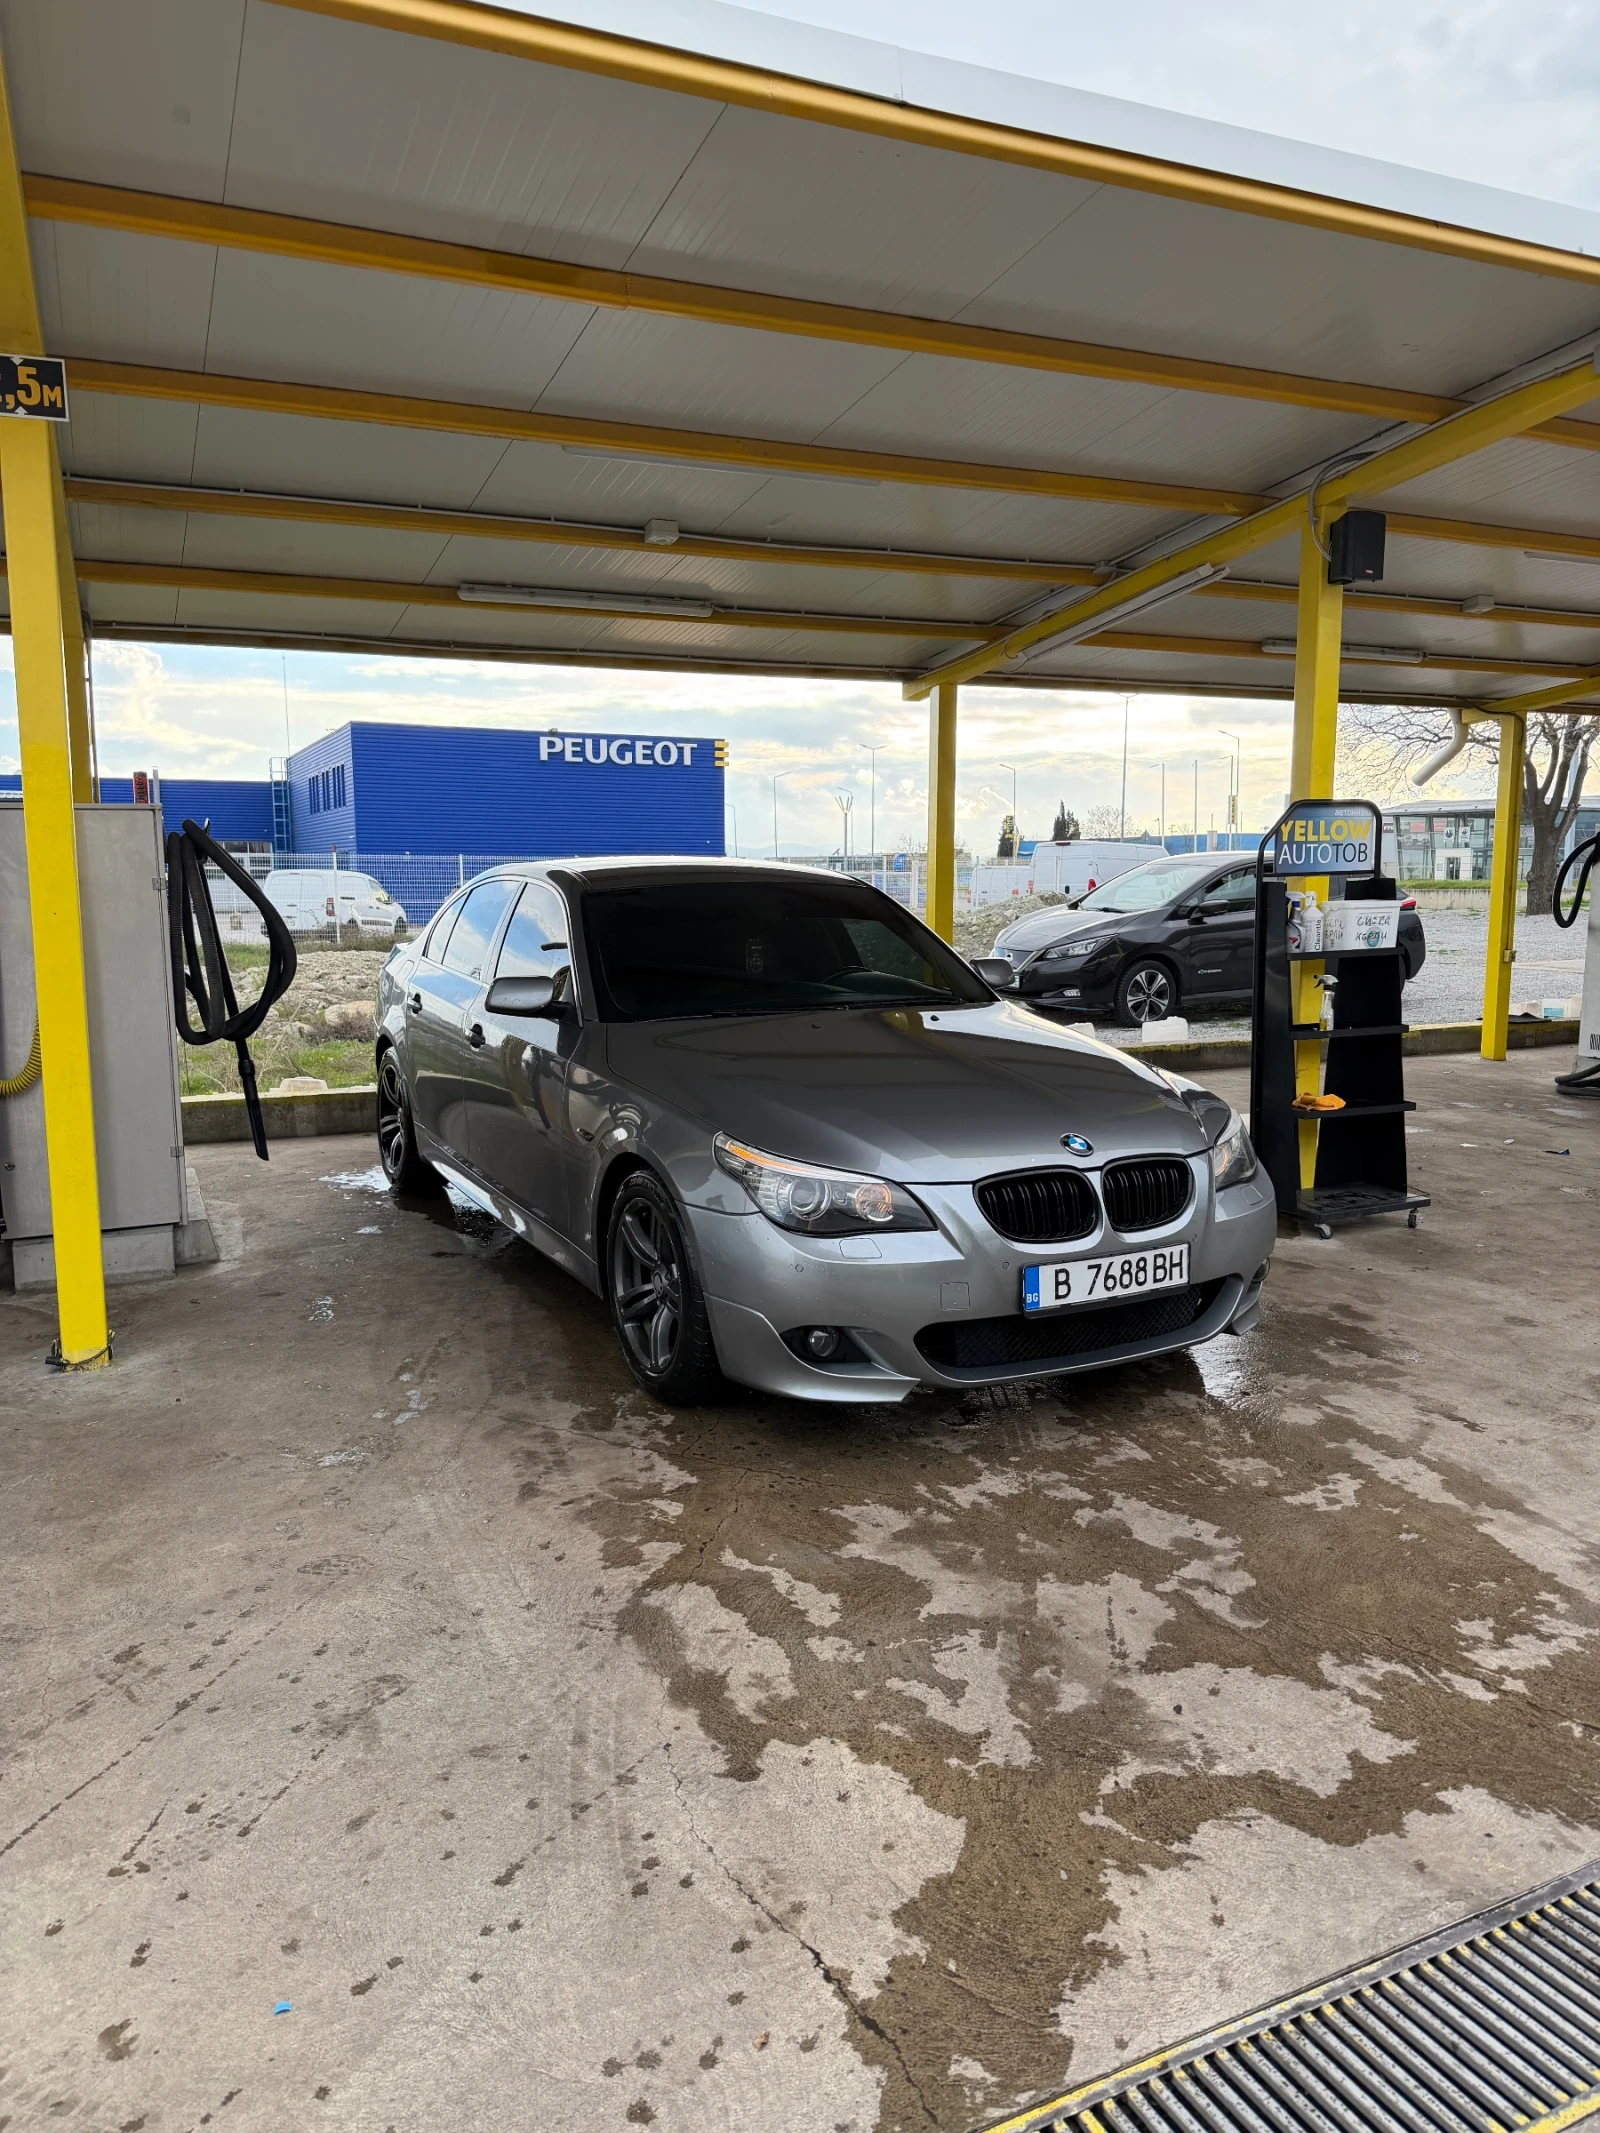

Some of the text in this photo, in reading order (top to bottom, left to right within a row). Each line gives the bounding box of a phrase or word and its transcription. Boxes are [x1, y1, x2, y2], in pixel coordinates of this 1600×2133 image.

[539, 736, 698, 766] PEUGEOT
[1280, 819, 1371, 842] YELLOW
[1278, 843, 1368, 864] AUTOTOB
[1054, 1268, 1071, 1300] B
[1087, 1256, 1147, 1296] 7688
[1026, 1292, 1039, 1303] BG
